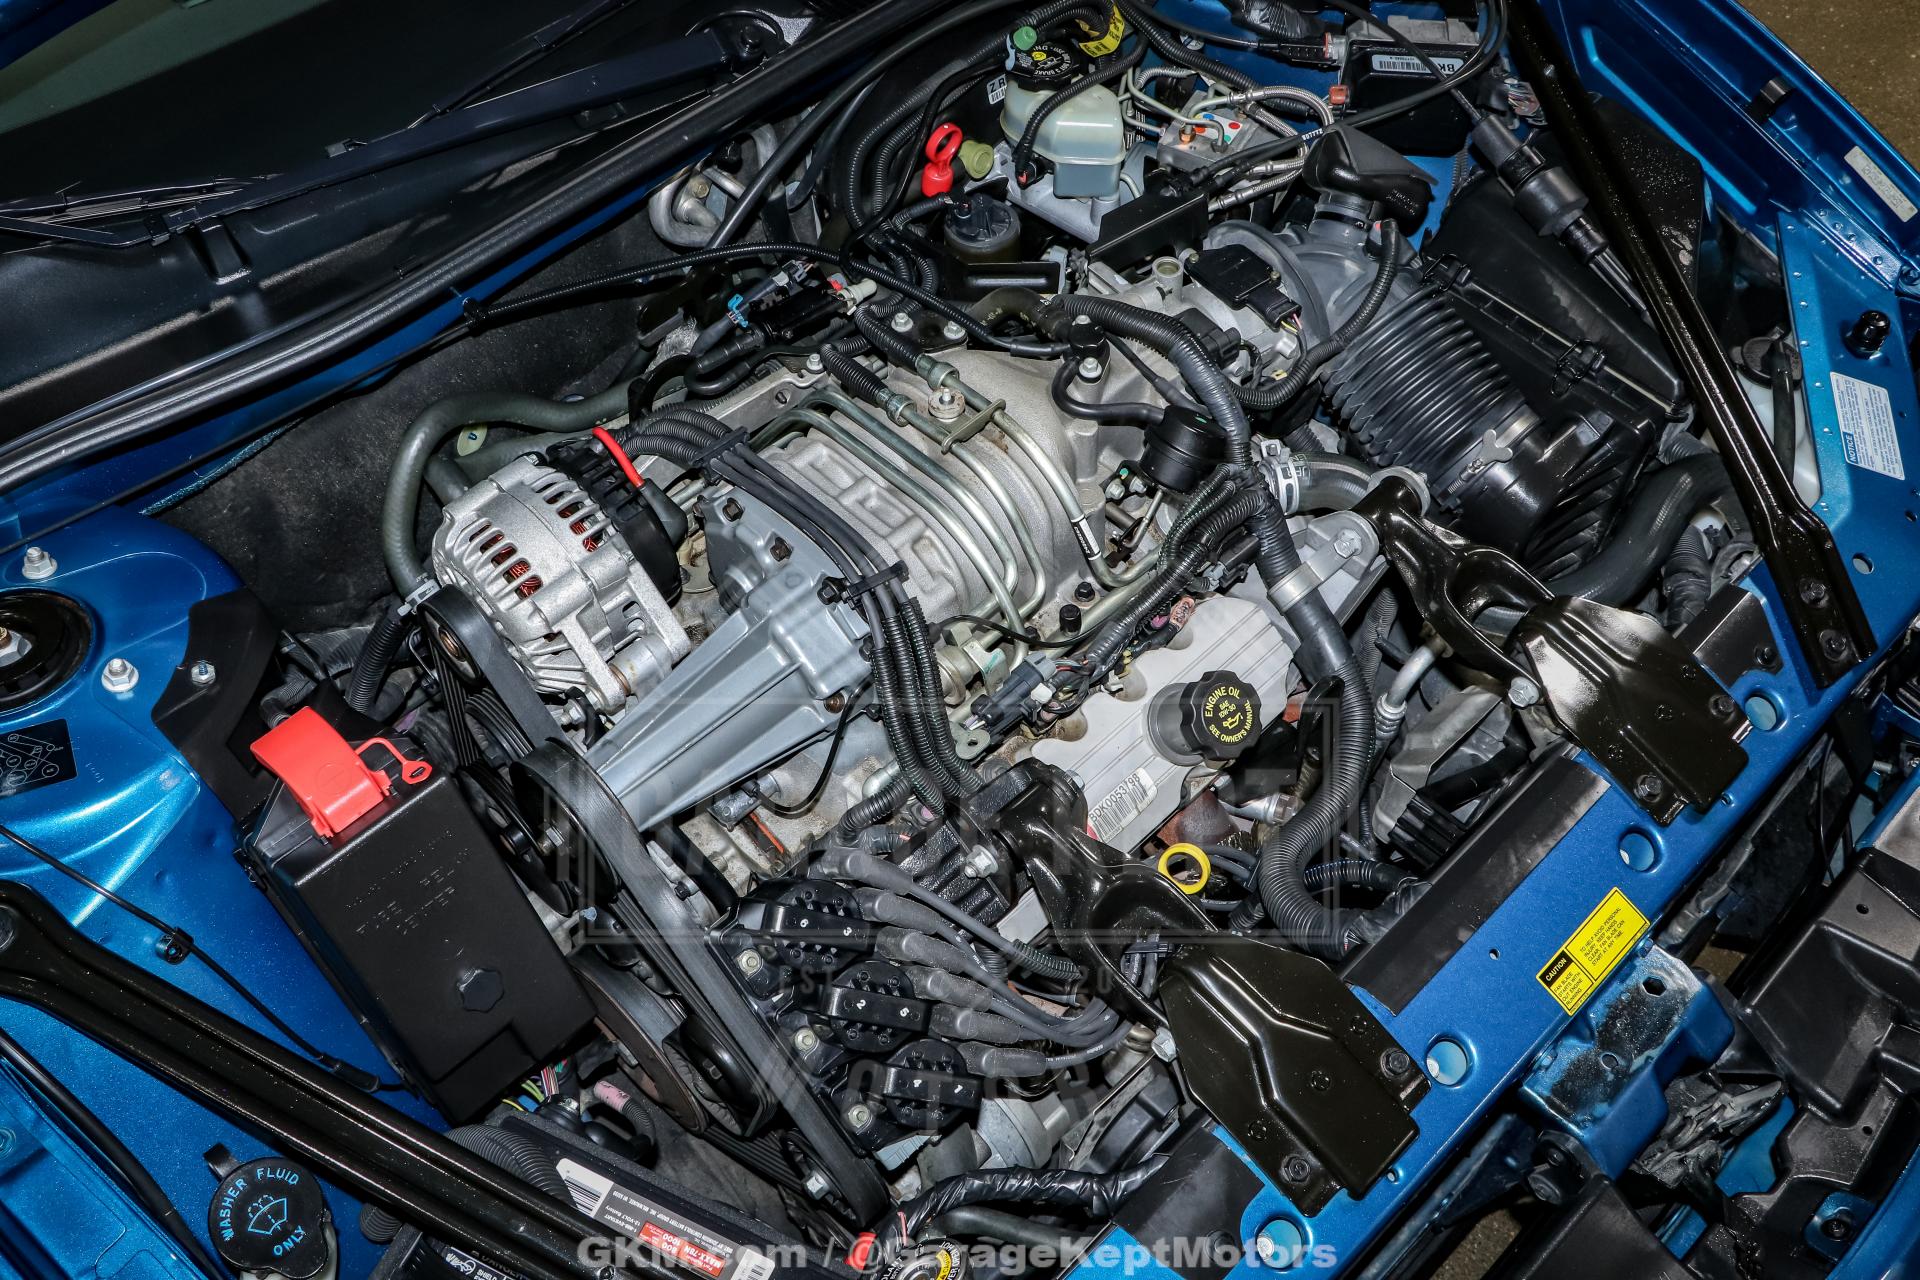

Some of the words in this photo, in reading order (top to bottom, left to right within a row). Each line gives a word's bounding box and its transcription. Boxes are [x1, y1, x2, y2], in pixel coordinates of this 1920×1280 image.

[1845, 434, 1857, 463] NOTICE
[1205, 686, 1227, 717] ENGINE
[1228, 686, 1241, 700] OIL
[1209, 724, 1221, 739] SEE
[1220, 729, 1248, 744] OWNER'S
[1244, 699, 1253, 731] MANUAL
[843, 926, 853, 937] 3
[1545, 957, 1567, 981] CAUTION
[857, 999, 866, 1010] 2
[913, 1079, 922, 1088] 4
[220, 1178, 247, 1242] WASHER
[257, 1167, 300, 1186] FLUID
[604, 1204, 622, 1217] Battery
[273, 1224, 306, 1256] ONLY
[661, 1232, 681, 1246] 1000
[661, 1240, 678, 1254] 800
[939, 1241, 955, 1254] HOT
[880, 1257, 903, 1280] OLANT
